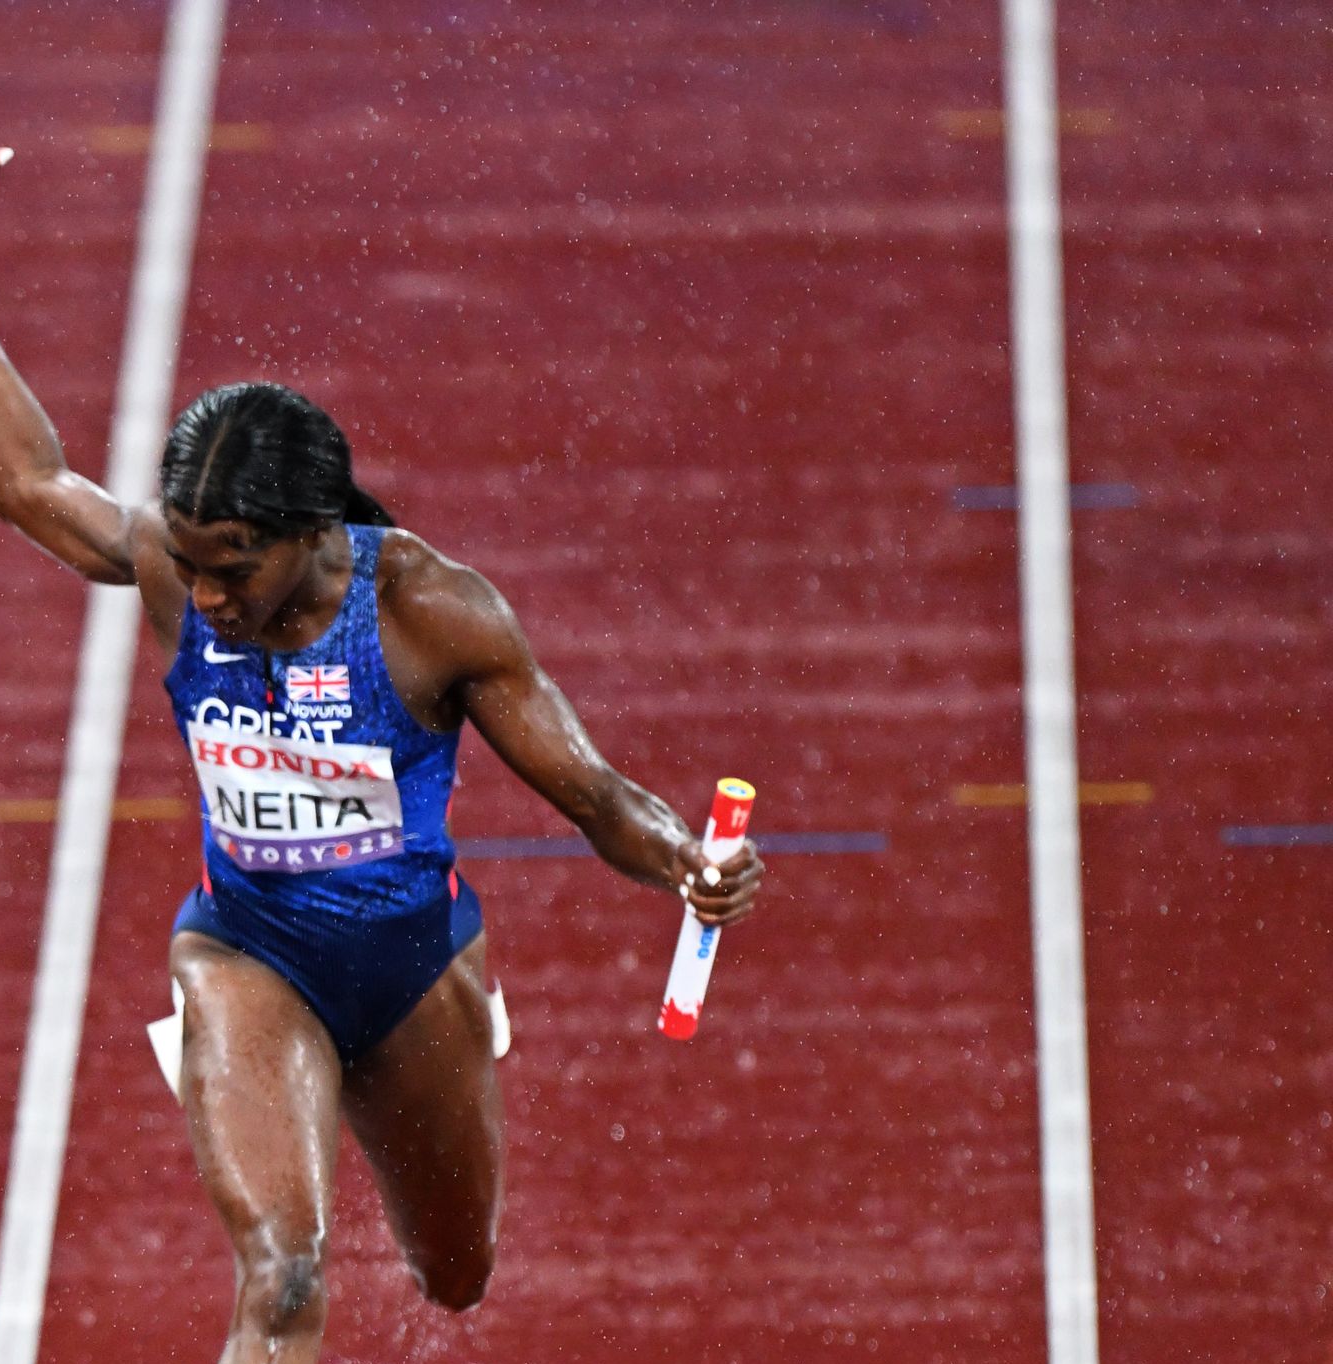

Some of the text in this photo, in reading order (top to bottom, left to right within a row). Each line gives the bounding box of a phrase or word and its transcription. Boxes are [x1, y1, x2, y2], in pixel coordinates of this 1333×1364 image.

[285, 702, 352, 719] Novuna
[196, 738, 379, 781] HONDA
[217, 786, 374, 830] NEITA
